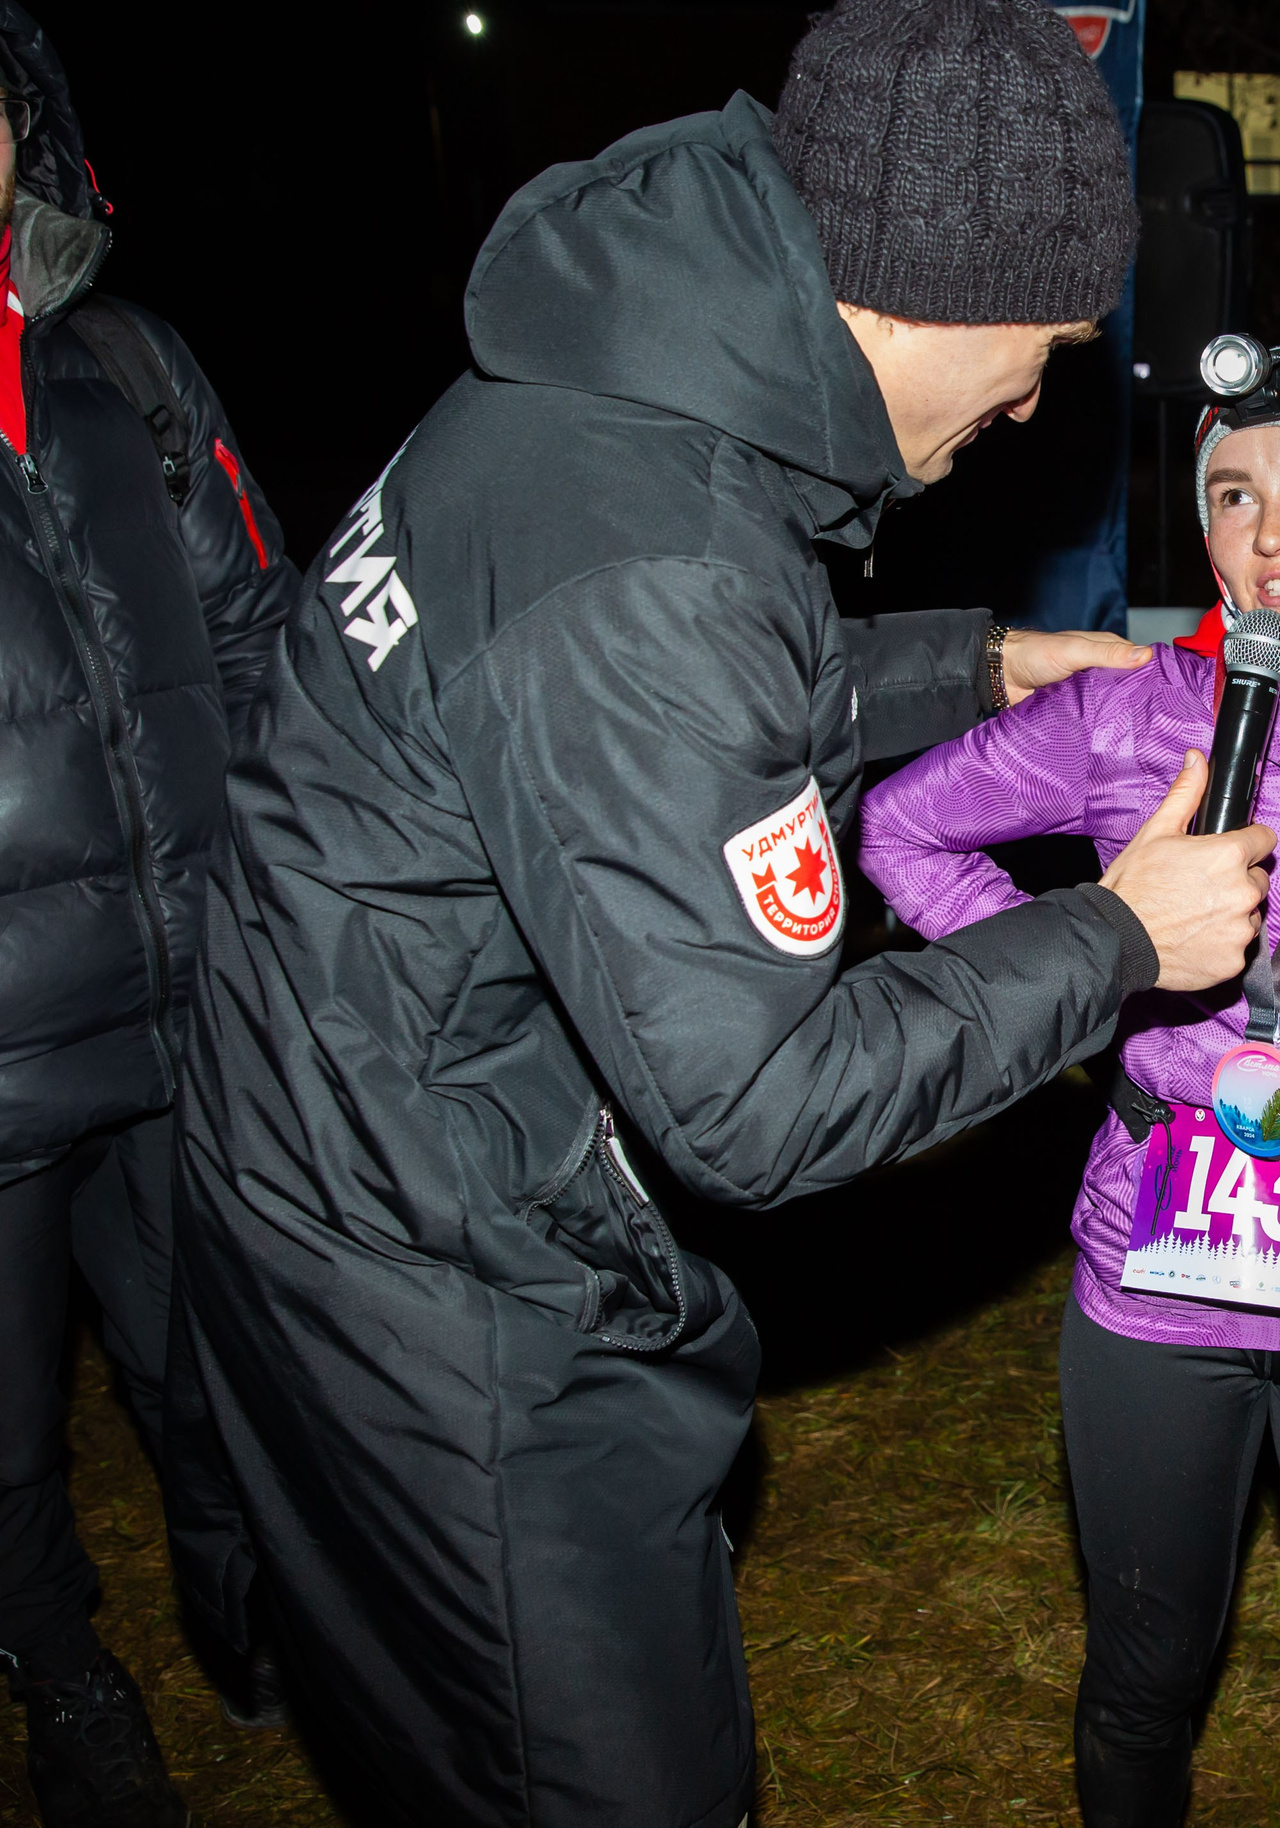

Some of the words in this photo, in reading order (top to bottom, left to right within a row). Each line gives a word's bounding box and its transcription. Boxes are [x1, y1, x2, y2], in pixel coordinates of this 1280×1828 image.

[1231, 678, 1258, 689] SHURE
[741, 789, 820, 862] УДМУРТИ
[762, 893, 836, 936] ТЕРРИТОРИЯ
